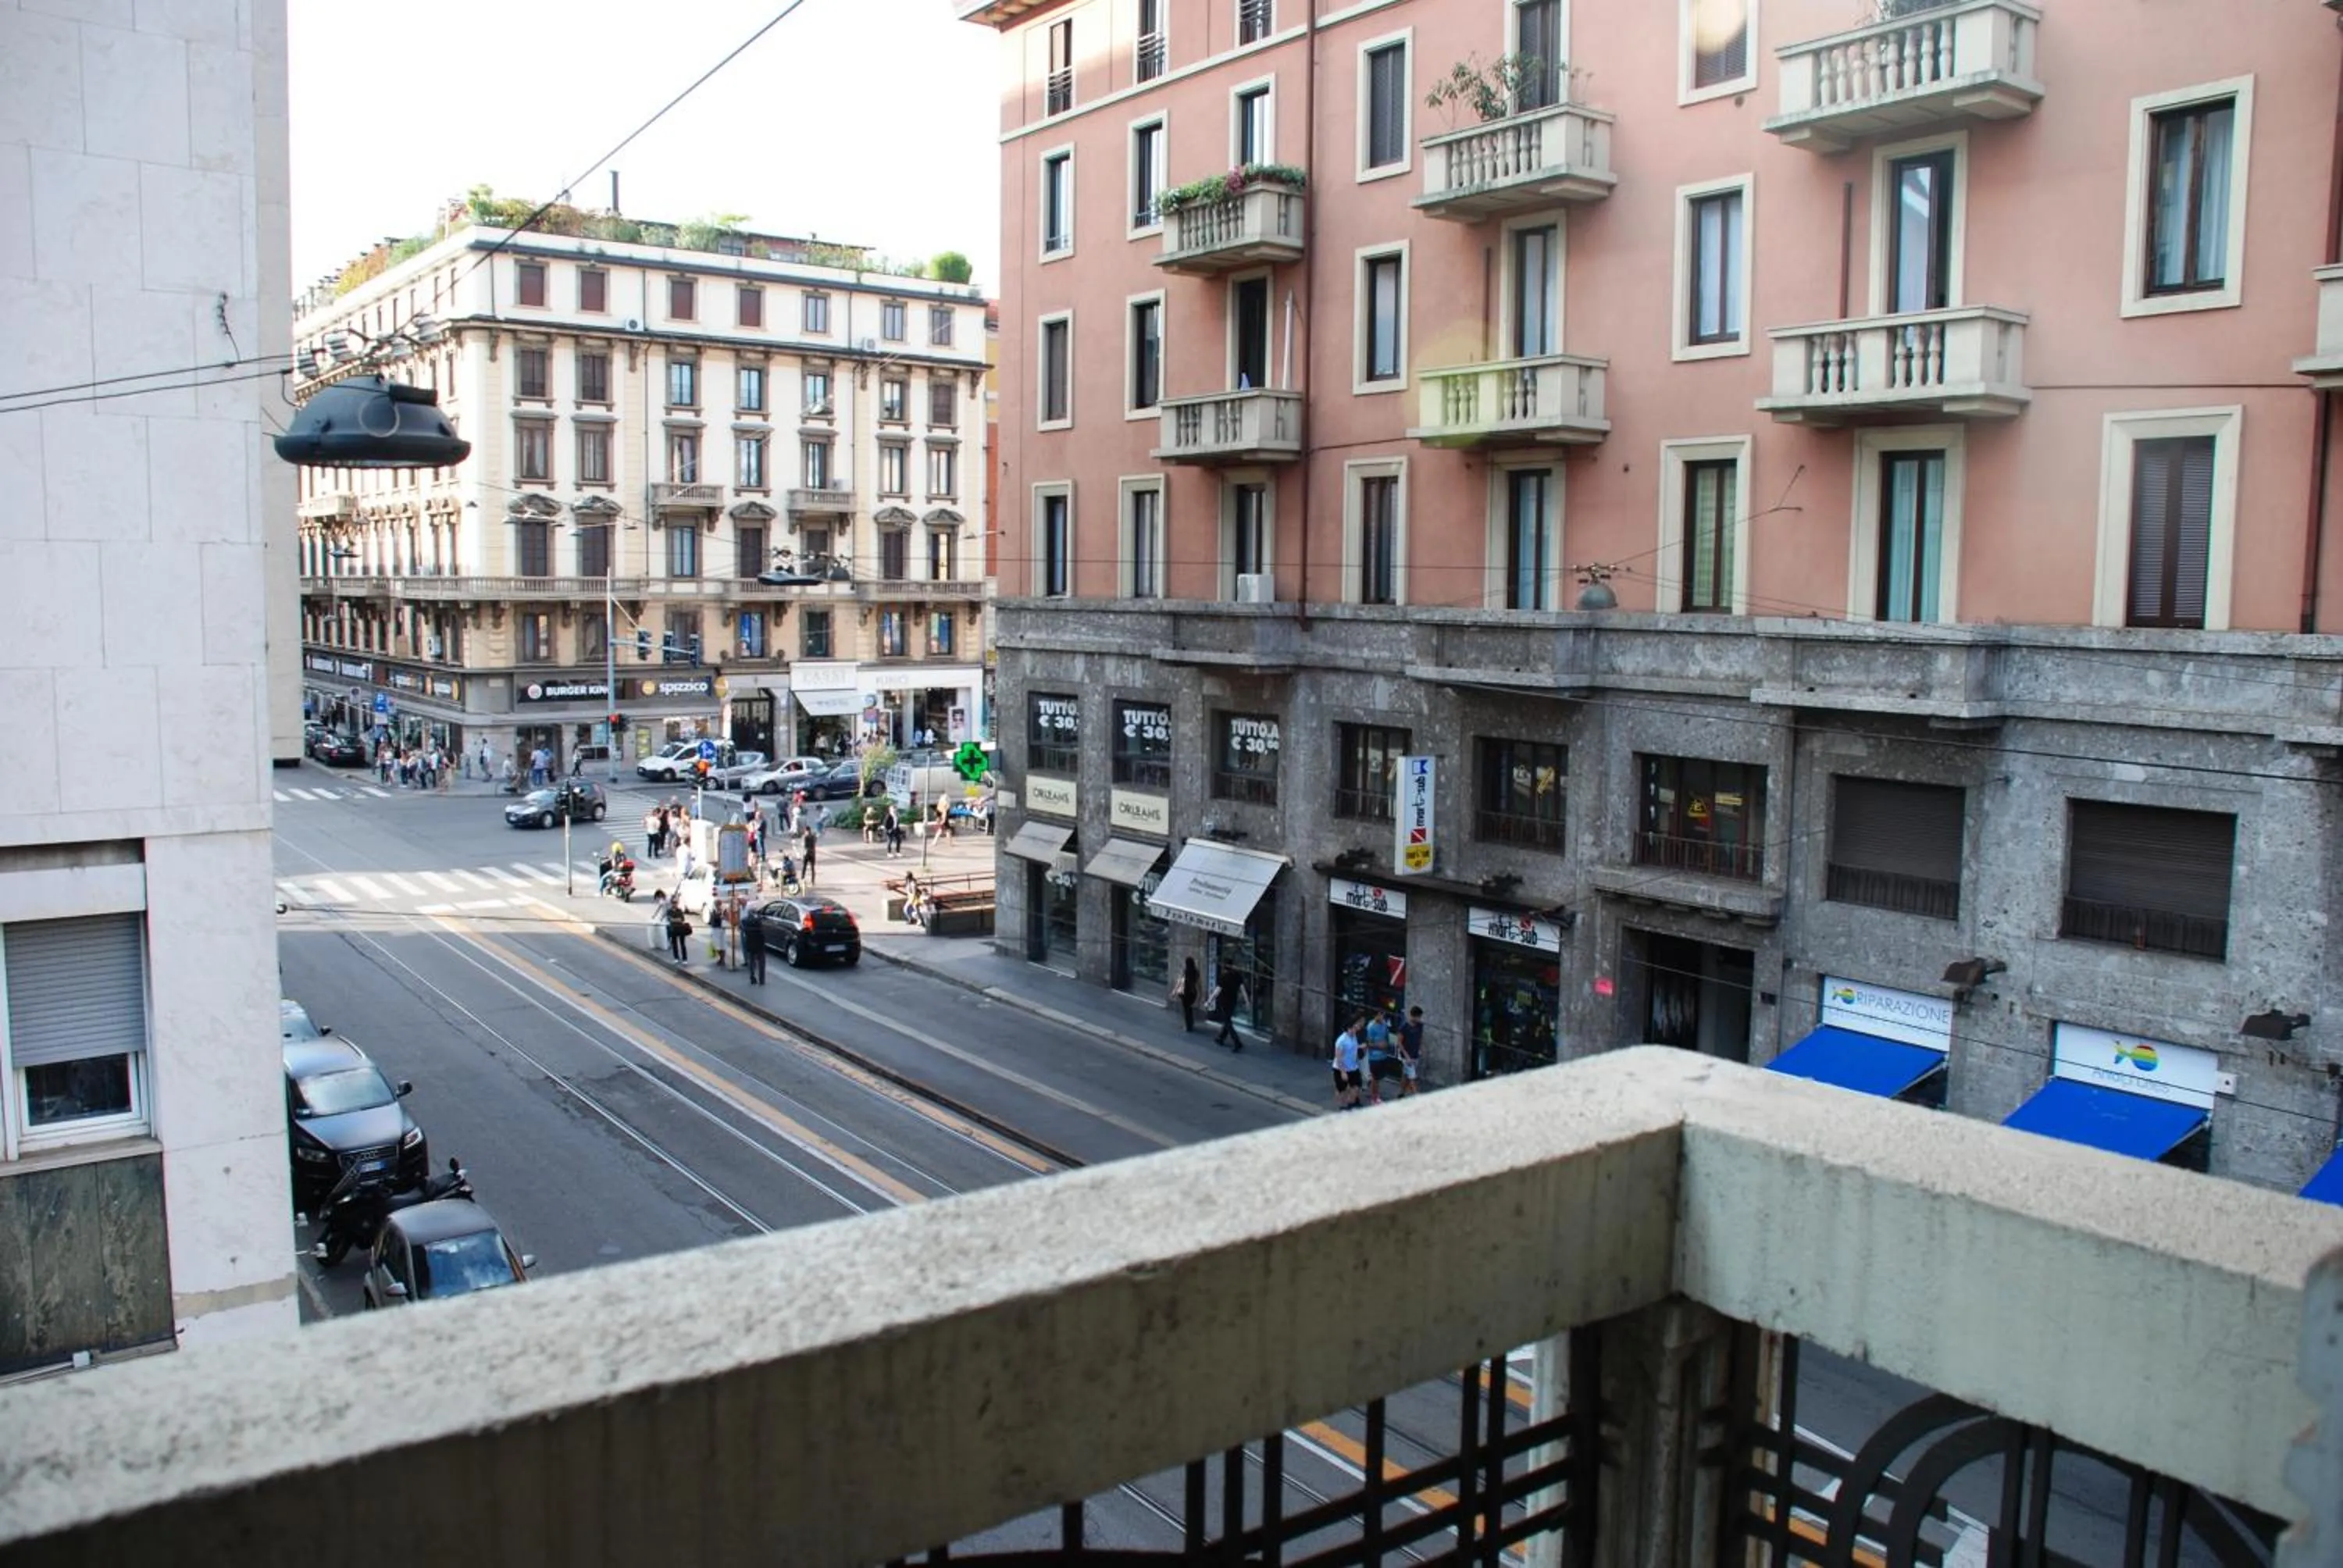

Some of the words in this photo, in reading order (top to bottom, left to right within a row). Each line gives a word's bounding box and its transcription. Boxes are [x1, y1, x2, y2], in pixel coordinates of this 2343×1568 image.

[546, 686, 587, 697] BURGER
[659, 681, 708, 697] spizzico
[1231, 718, 1267, 738] TUTTO
[1856, 990, 1951, 1025] RIPARAZIONE
